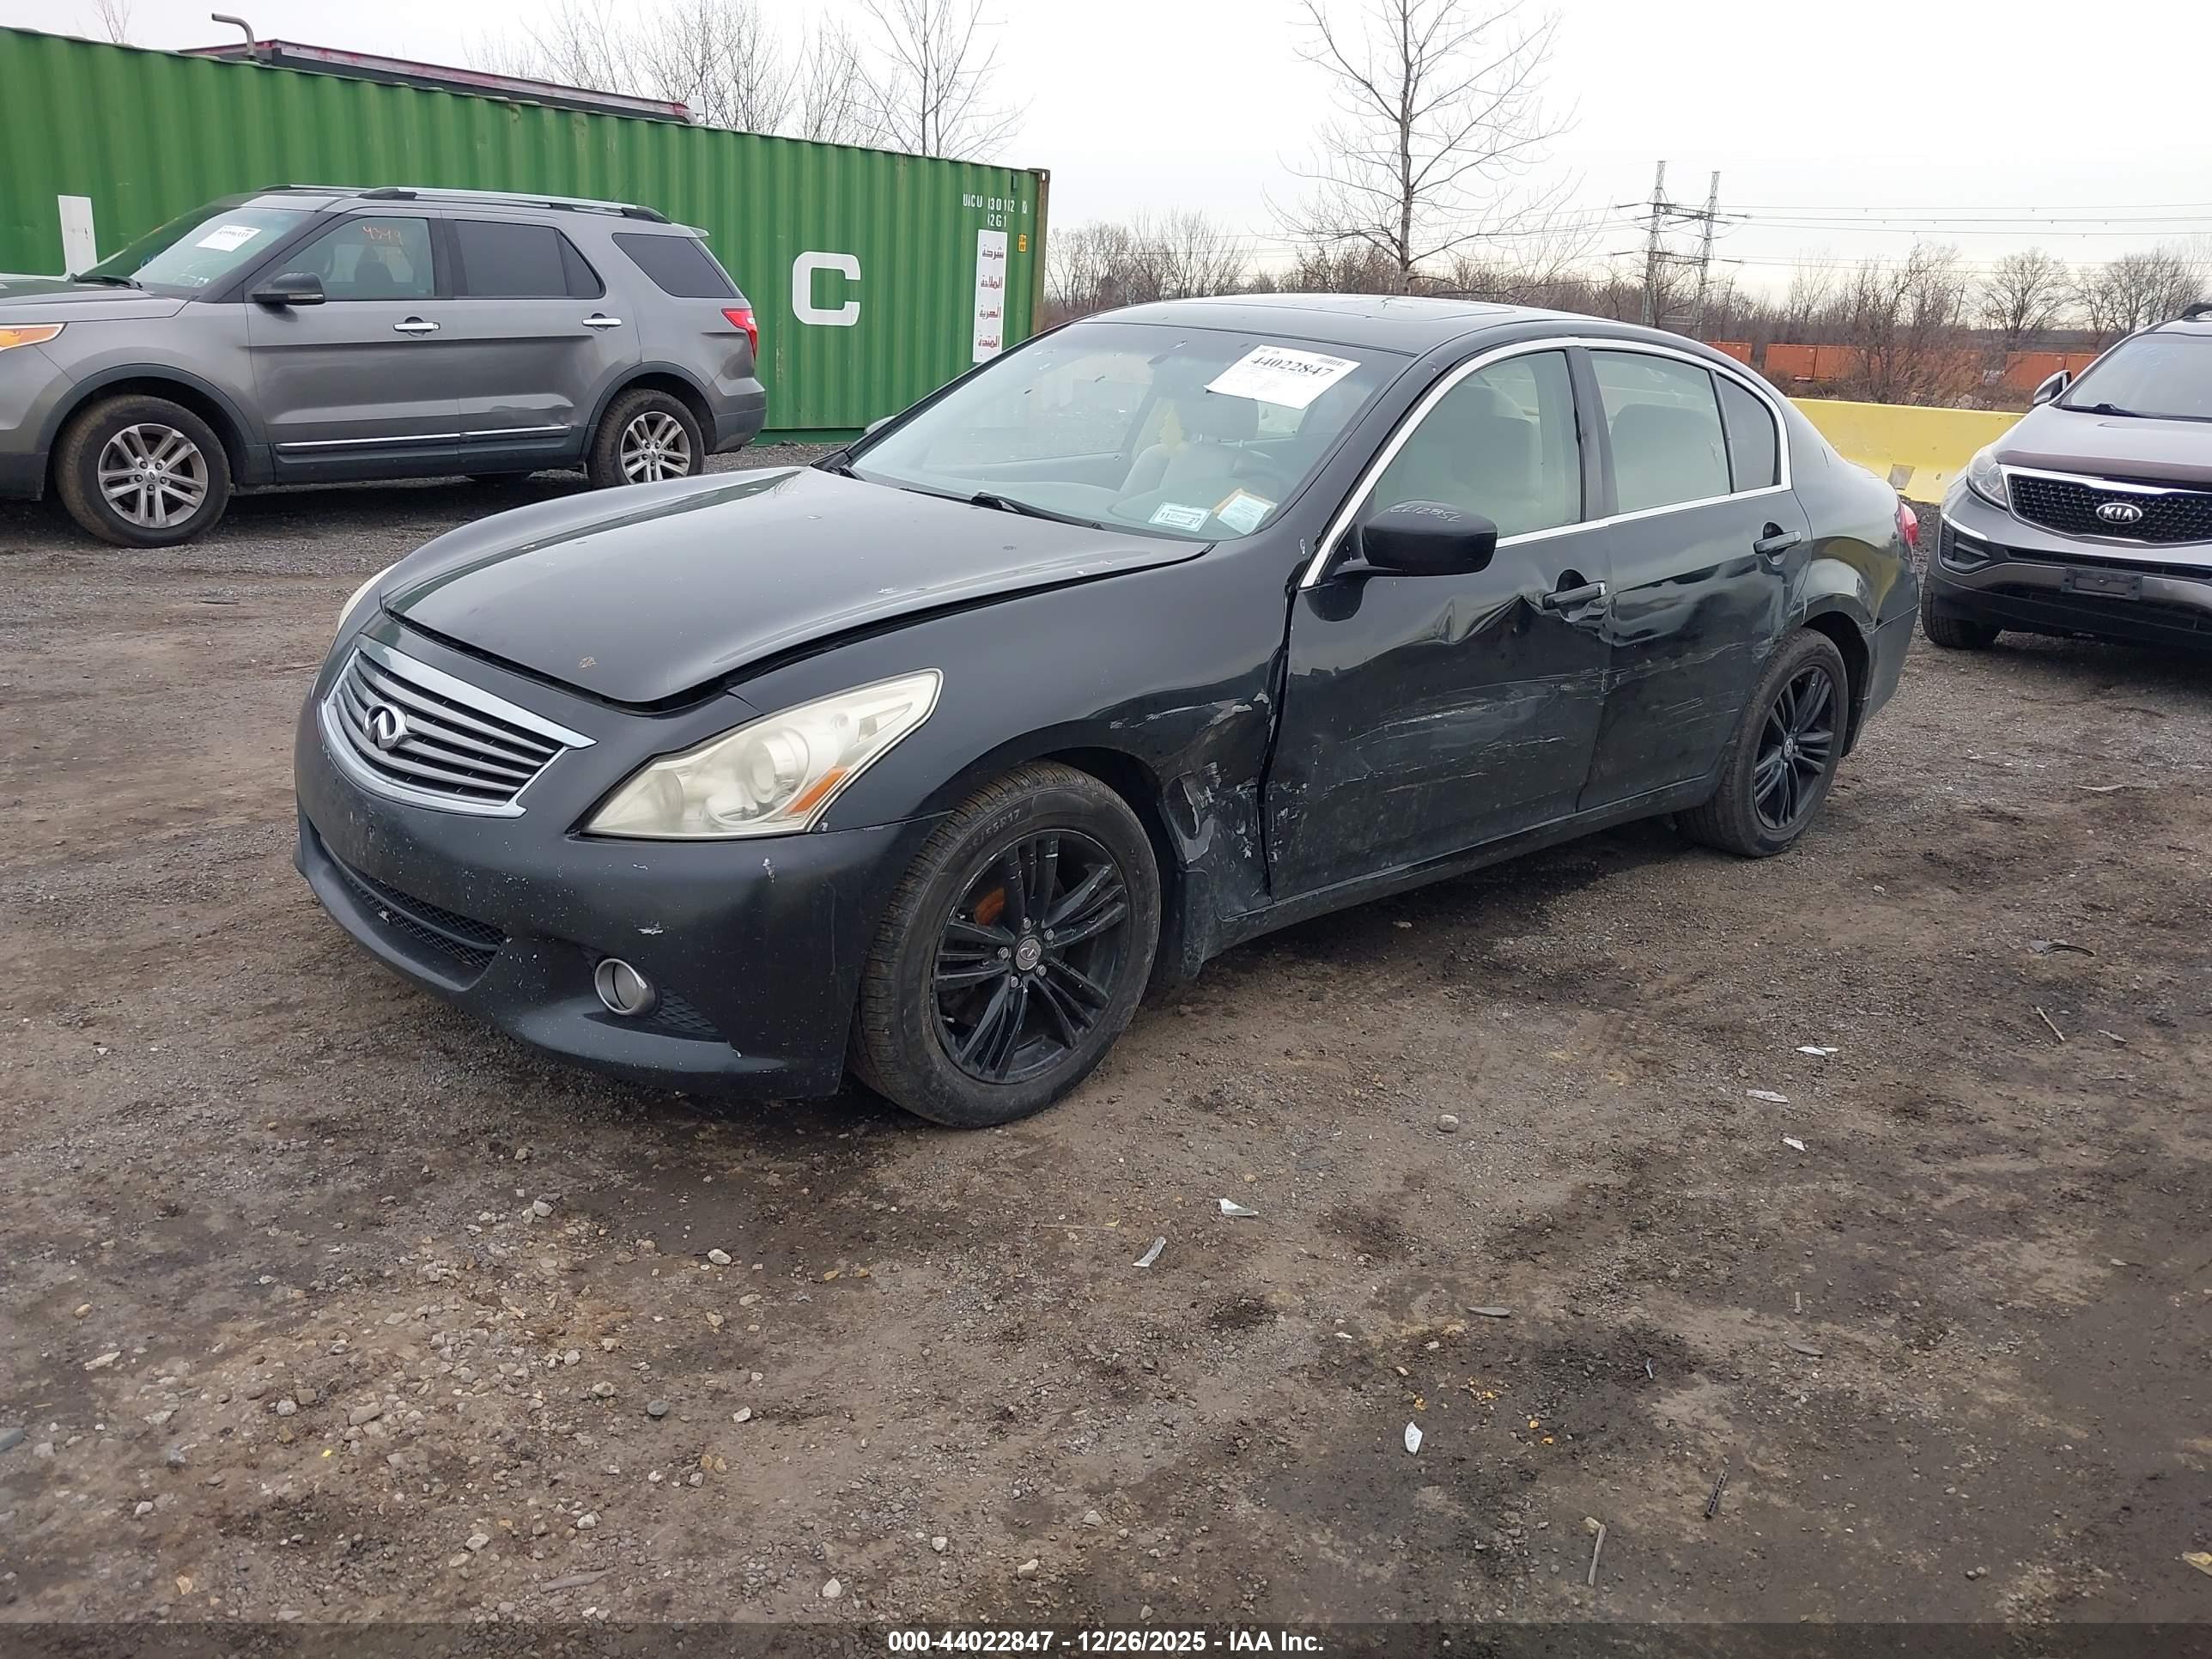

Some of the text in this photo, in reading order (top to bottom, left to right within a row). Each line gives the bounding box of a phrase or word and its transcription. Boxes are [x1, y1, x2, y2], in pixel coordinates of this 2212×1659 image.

[793, 251, 861, 326] C
[1250, 356, 1335, 377] 44022847
[2103, 507, 2134, 520] KIA
